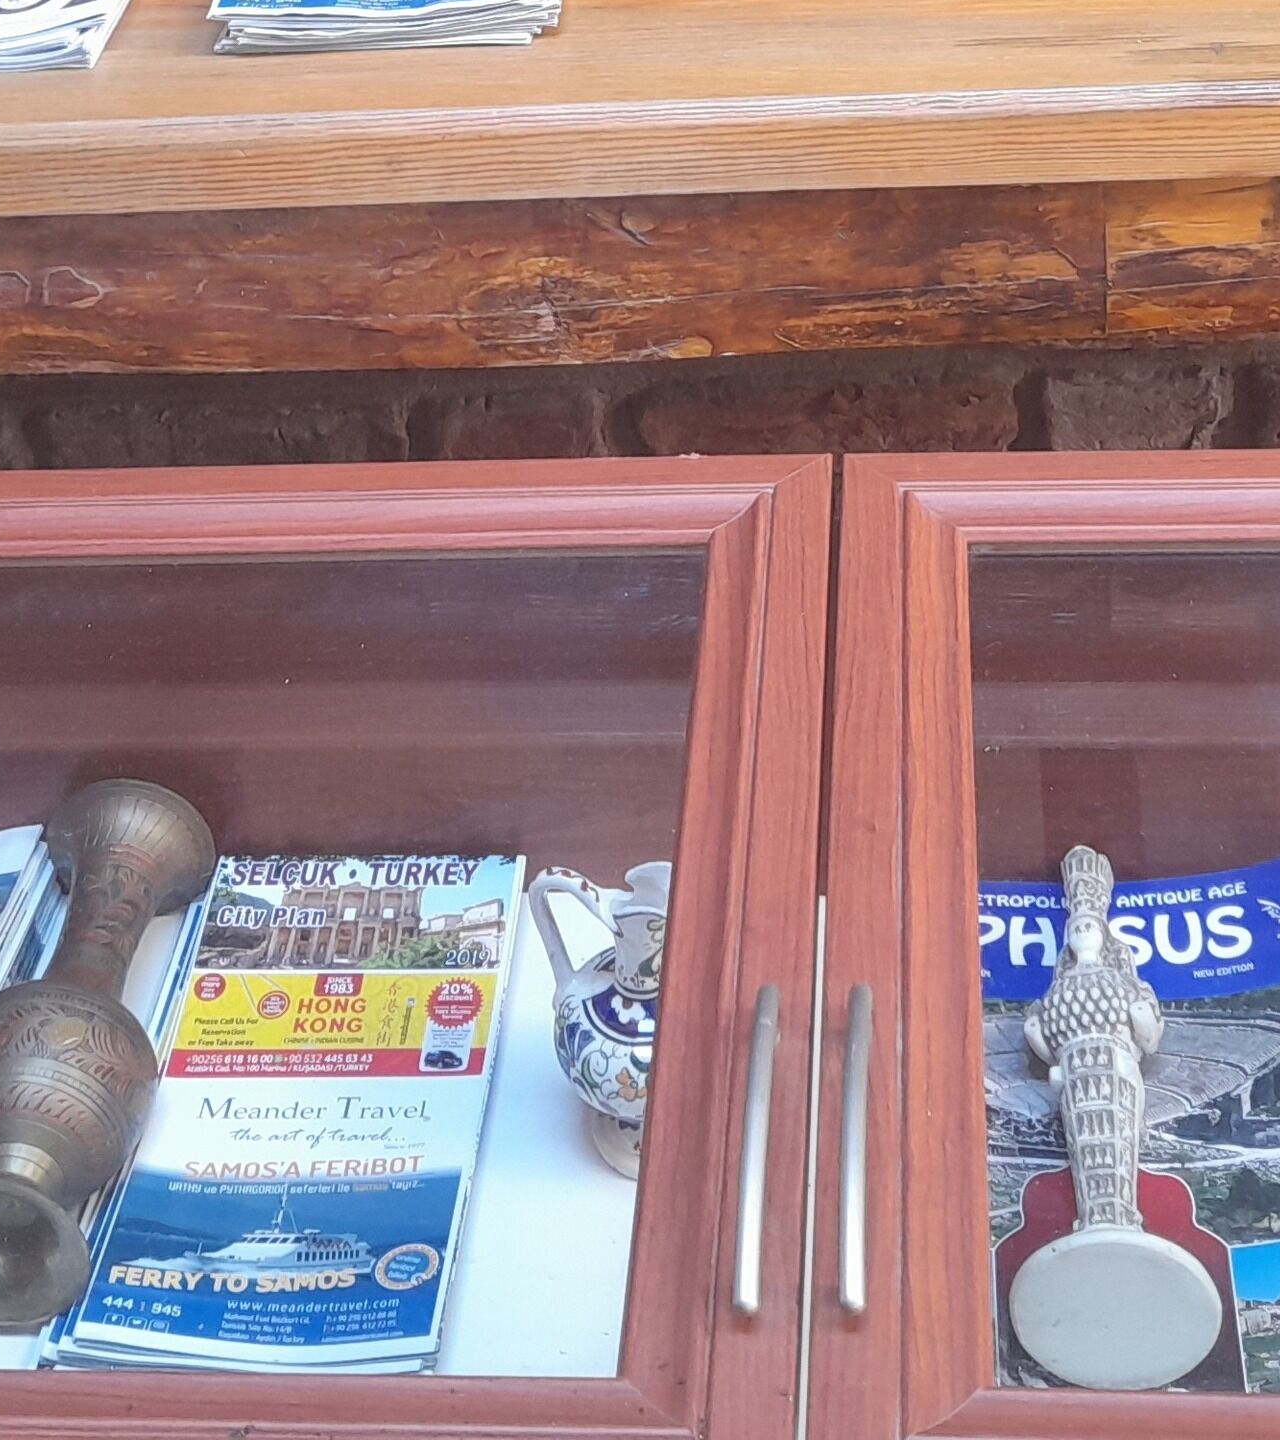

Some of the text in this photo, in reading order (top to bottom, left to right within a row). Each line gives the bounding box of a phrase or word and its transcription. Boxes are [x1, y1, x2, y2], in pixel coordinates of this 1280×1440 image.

[230, 860, 340, 892] SELÇUK
[1116, 889, 1203, 909] ANTIQUE
[1207, 881, 1248, 899] AGE
[216, 905, 327, 929] City Plan
[979, 905, 1253, 968] PHSUS
[444, 949, 492, 967] 2019
[1193, 962, 1256, 979] NEW EDITION
[323, 983, 354, 994] 1983
[326, 976, 353, 985] SINCE
[440, 983, 473, 994] 20%
[297, 997, 368, 1014] HONG
[293, 1017, 363, 1033] KONG
[224, 1054, 243, 1063] 618
[246, 1054, 258, 1063] 16
[260, 1054, 273, 1063] 00
[324, 1053, 343, 1063] 445
[195, 1096, 428, 1120] Meander Travel
[230, 1127, 262, 1143] the
[268, 1128, 304, 1142] art
[305, 1126, 327, 1149] of
[184, 1160, 302, 1180] SAMOS'A
[108, 1265, 357, 1293] FERRY TO SAMOS
[102, 1295, 134, 1310] 444
[151, 1302, 182, 1317] 945
[227, 1298, 400, 1313] www.meandertravel.com
